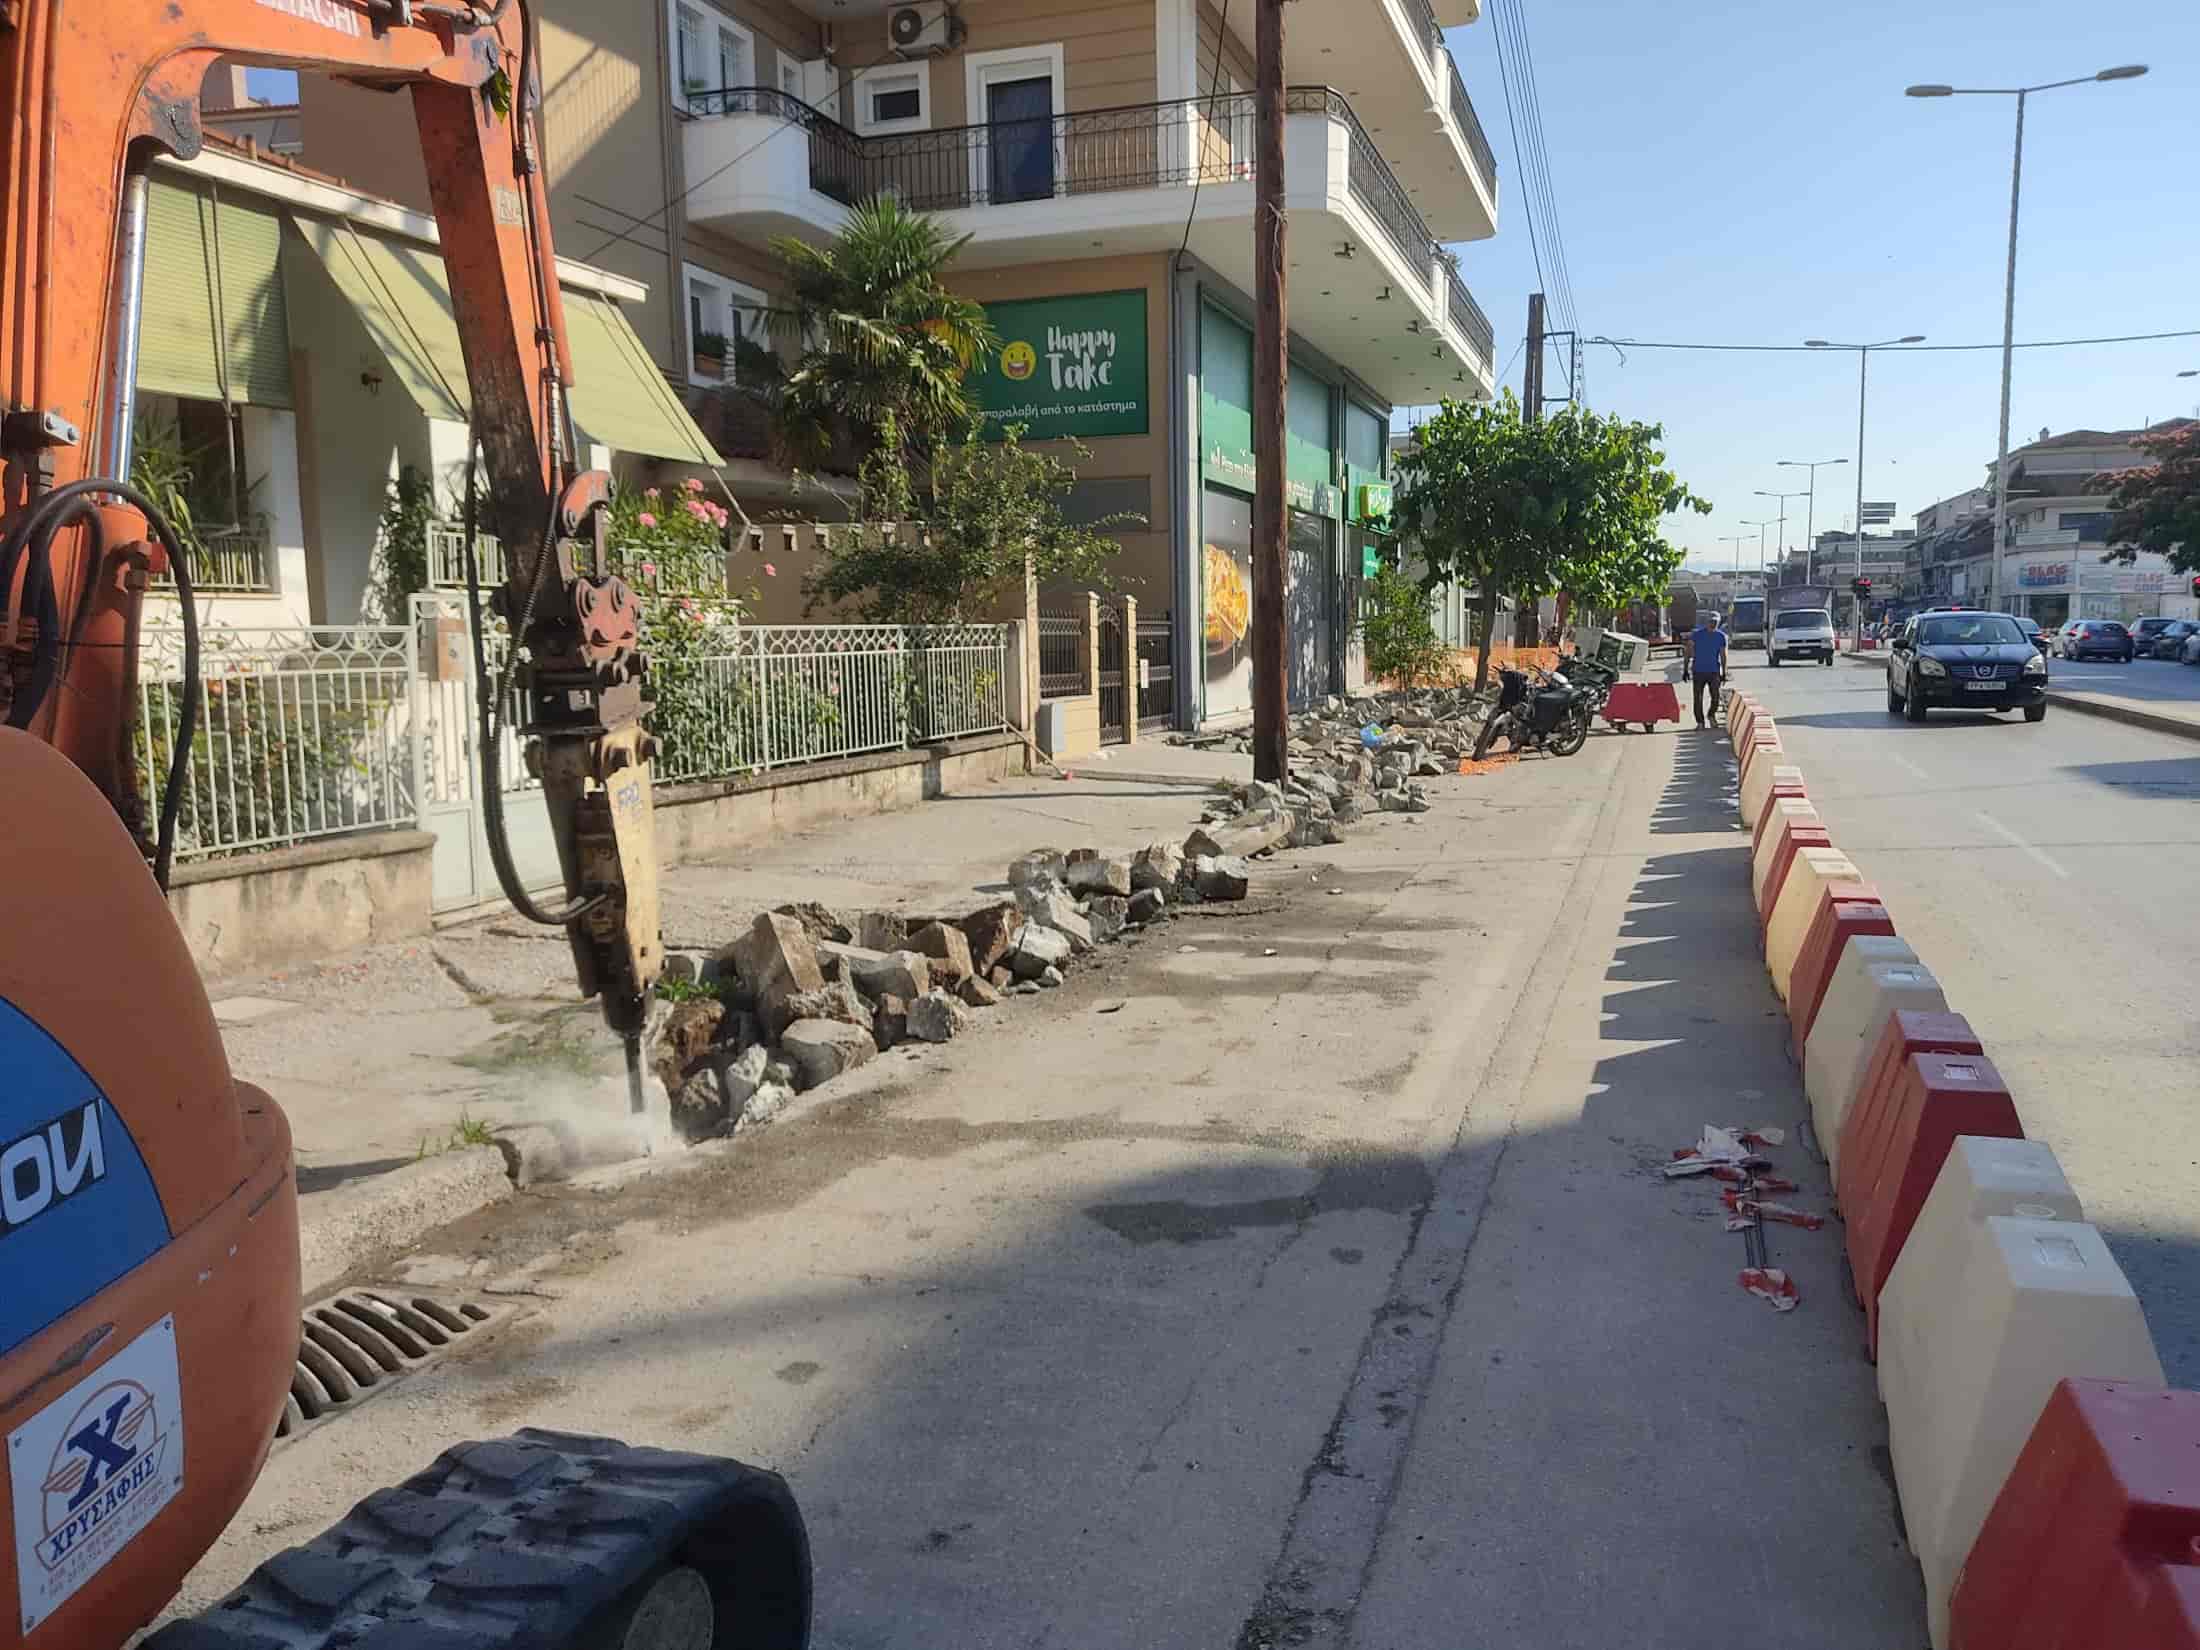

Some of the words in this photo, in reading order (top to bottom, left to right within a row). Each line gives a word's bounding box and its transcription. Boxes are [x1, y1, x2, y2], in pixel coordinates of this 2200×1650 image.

[1047, 325, 1116, 359] Happy
[1044, 351, 1113, 392] Take
[1040, 404, 1061, 418] από
[1063, 404, 1076, 414] το
[1077, 400, 1137, 414] κατάστημα
[50, 1453, 156, 1562] ΧΡΥΣΑΦΗΣ
